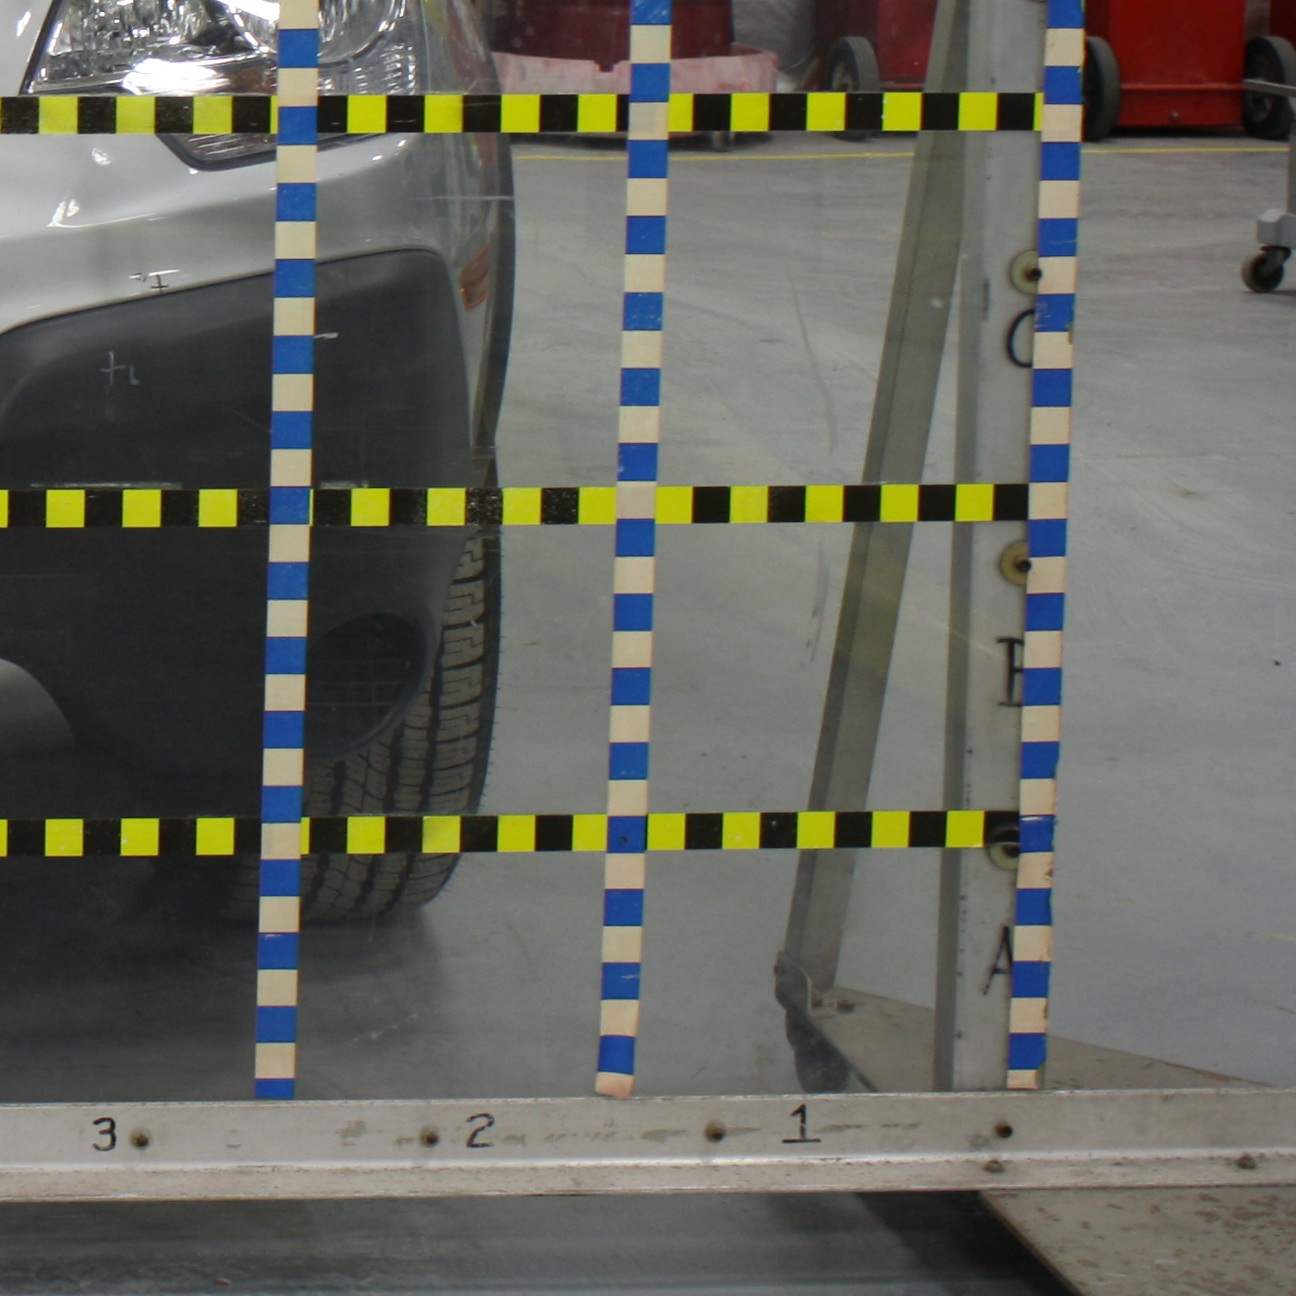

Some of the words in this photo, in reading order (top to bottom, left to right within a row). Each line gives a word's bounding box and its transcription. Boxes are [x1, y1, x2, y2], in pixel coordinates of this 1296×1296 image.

[93, 1117, 117, 1152] 3
[465, 1113, 496, 1149] 2
[781, 1104, 821, 1144] 1
